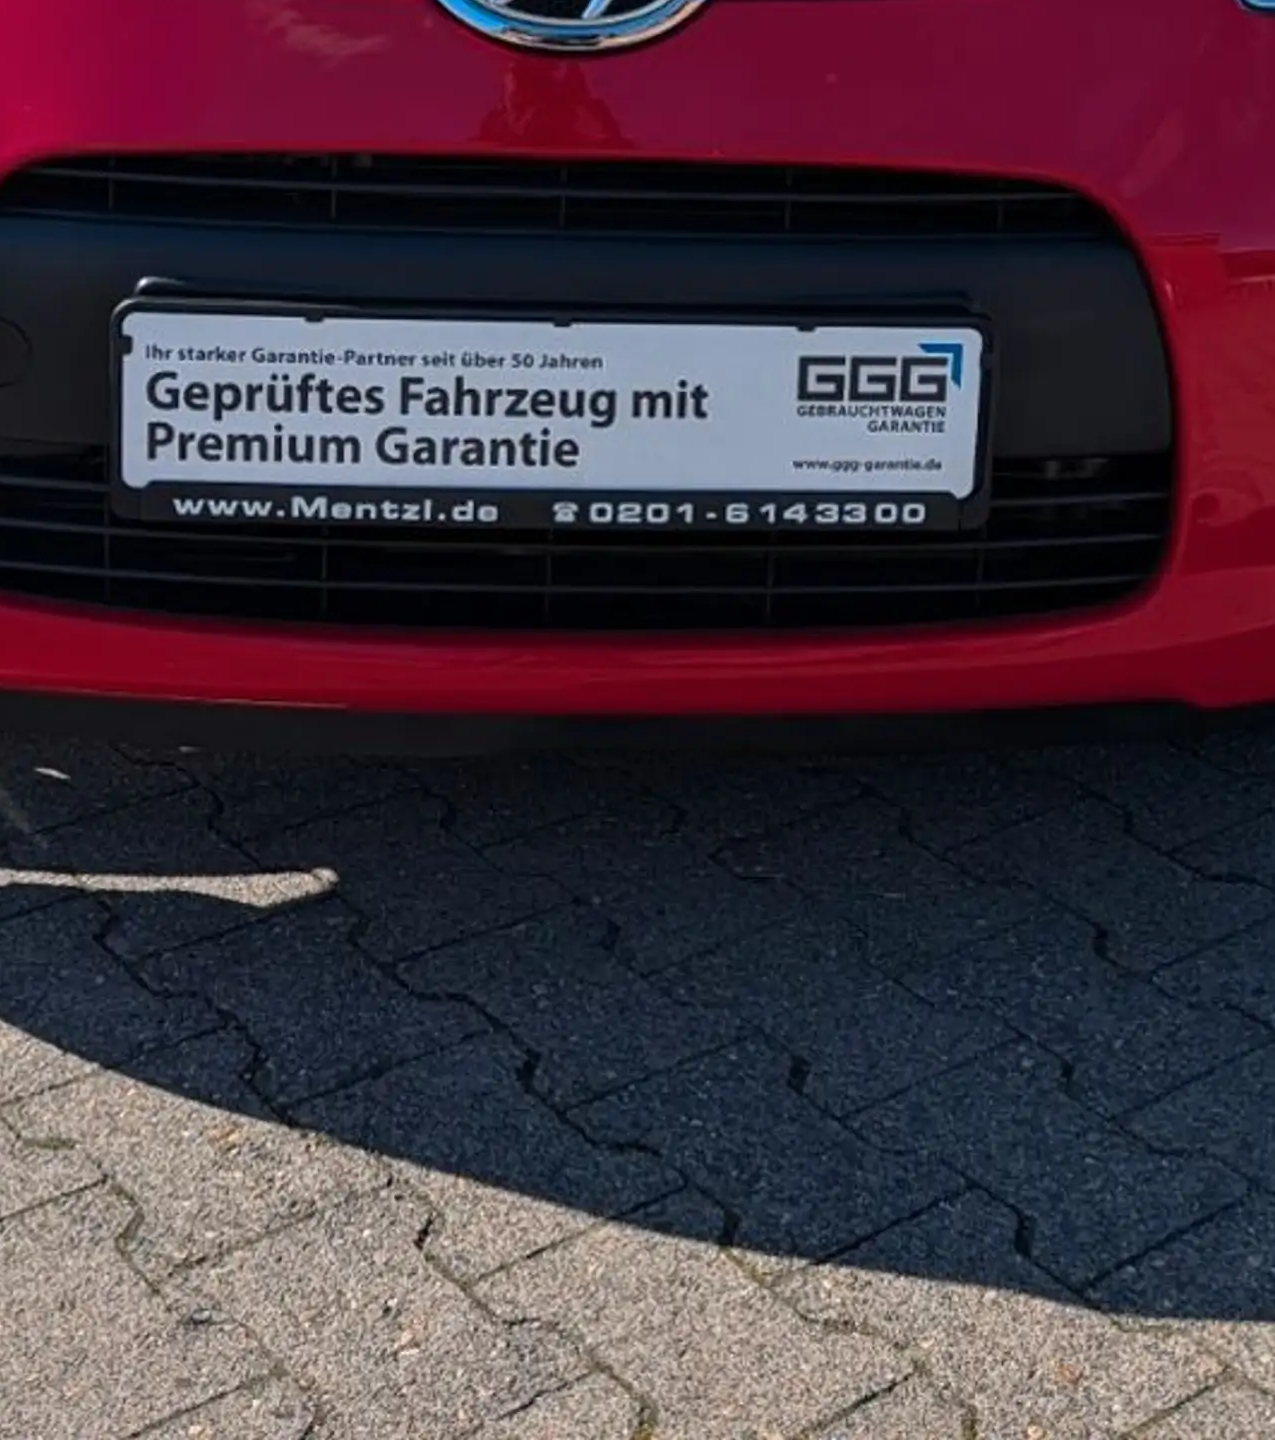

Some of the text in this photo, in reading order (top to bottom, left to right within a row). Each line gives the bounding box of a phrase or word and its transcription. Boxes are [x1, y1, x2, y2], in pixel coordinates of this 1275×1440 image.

[144, 345, 604, 371] Ihr starker Garantie-Partner seit über 50 Jahren
[796, 356, 948, 402] GGG
[146, 370, 710, 428] Geprüftes Fahrzeug mit
[796, 404, 947, 419] GEBRAUCHTWAGEN
[866, 419, 946, 434] GARANTIE
[146, 421, 580, 467] Premium Garantie
[791, 457, 943, 472] www.ggg-garantie.de
[172, 495, 499, 523] www.Mentzl.de
